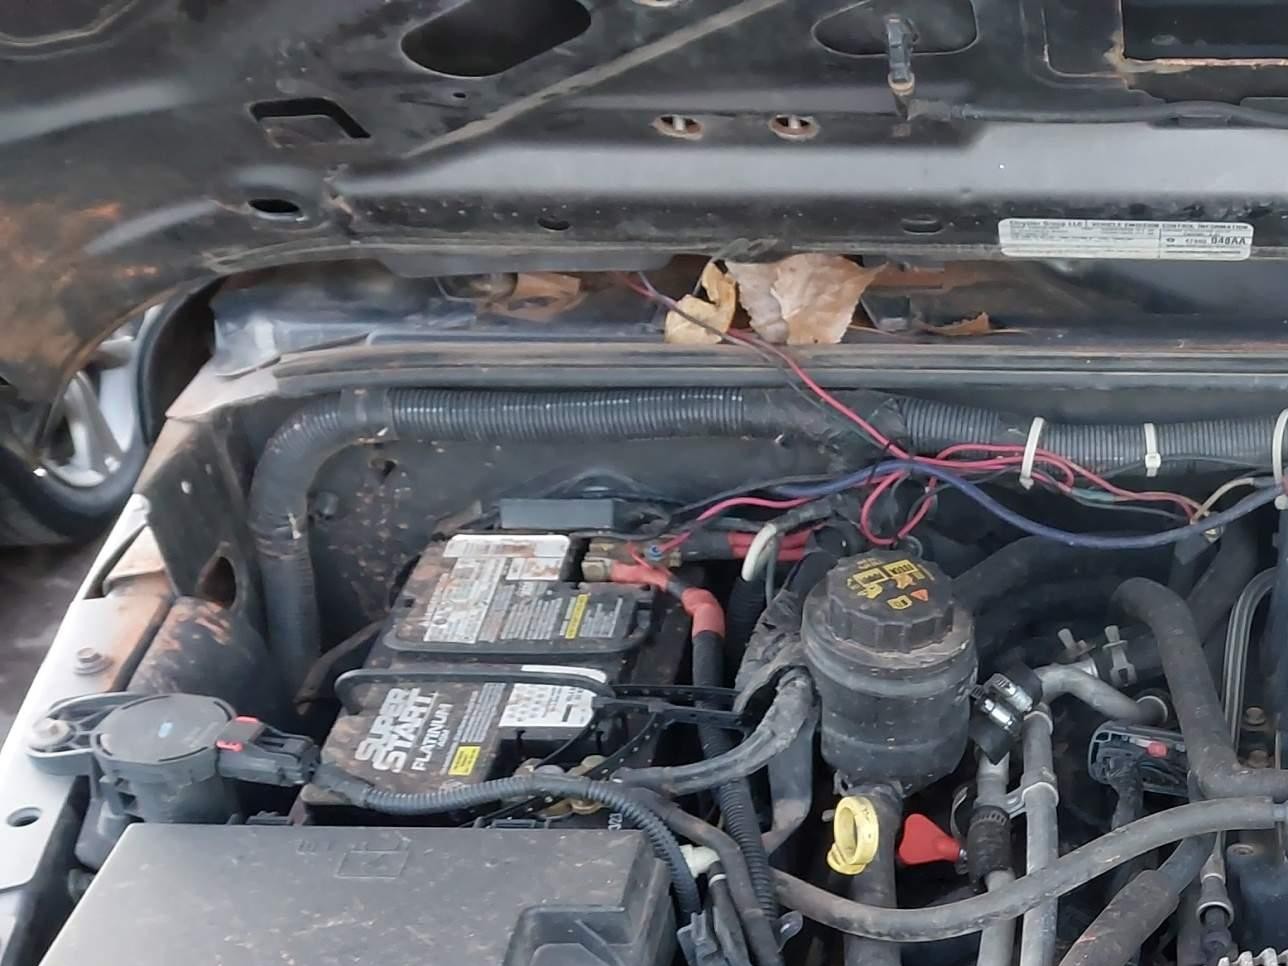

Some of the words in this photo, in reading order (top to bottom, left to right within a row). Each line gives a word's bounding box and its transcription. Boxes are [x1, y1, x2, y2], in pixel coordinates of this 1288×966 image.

[354, 687, 411, 761] SUPER
[372, 687, 434, 773] START
[411, 703, 454, 771] PLATINUM
